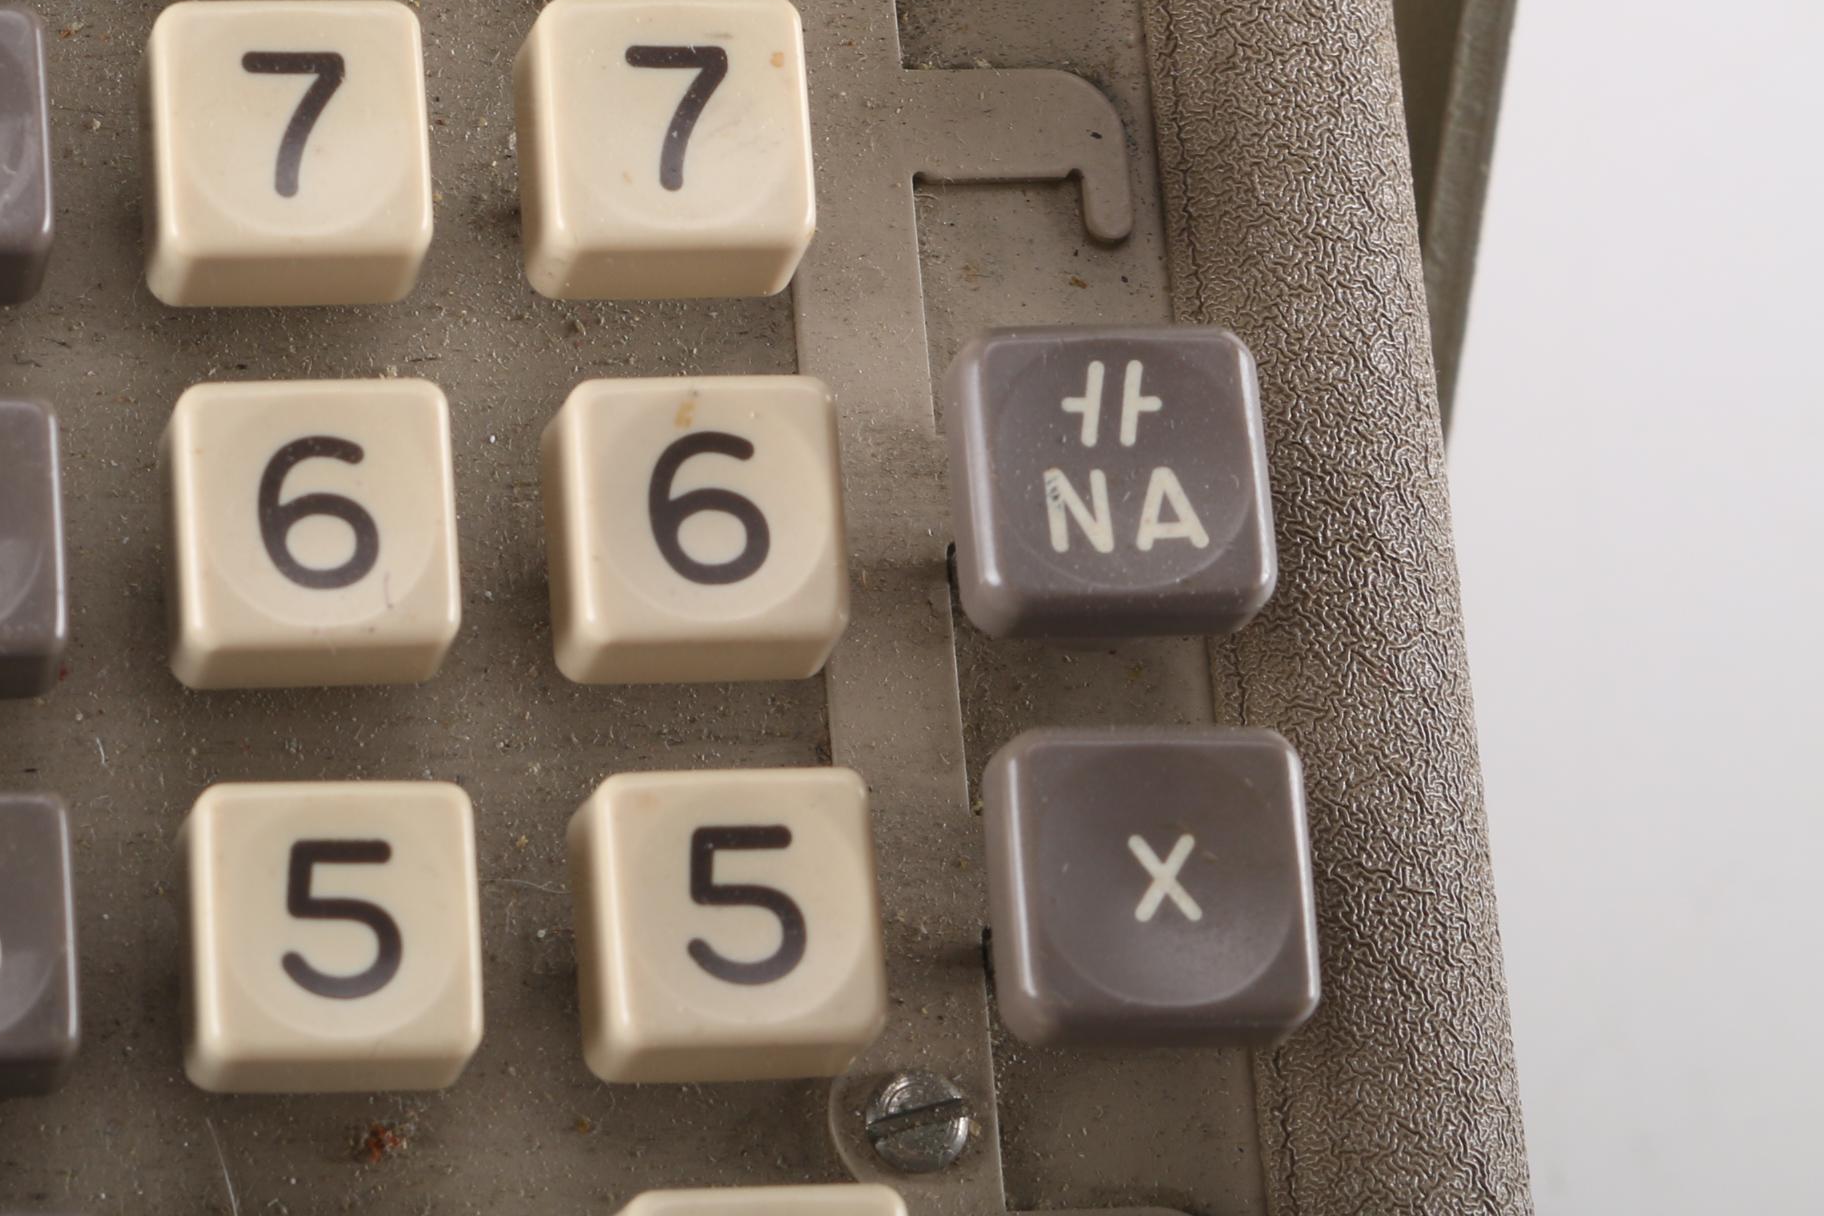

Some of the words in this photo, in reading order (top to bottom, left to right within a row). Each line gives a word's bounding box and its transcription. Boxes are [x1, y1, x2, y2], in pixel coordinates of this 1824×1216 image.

[241, 51, 345, 196] 7
[625, 45, 728, 191] 7
[258, 436, 379, 589] 6
[648, 431, 769, 585] 6
[1043, 466, 1210, 555] NA
[282, 839, 402, 999] 5
[688, 825, 806, 985] 5
[1126, 833, 1203, 923] X
